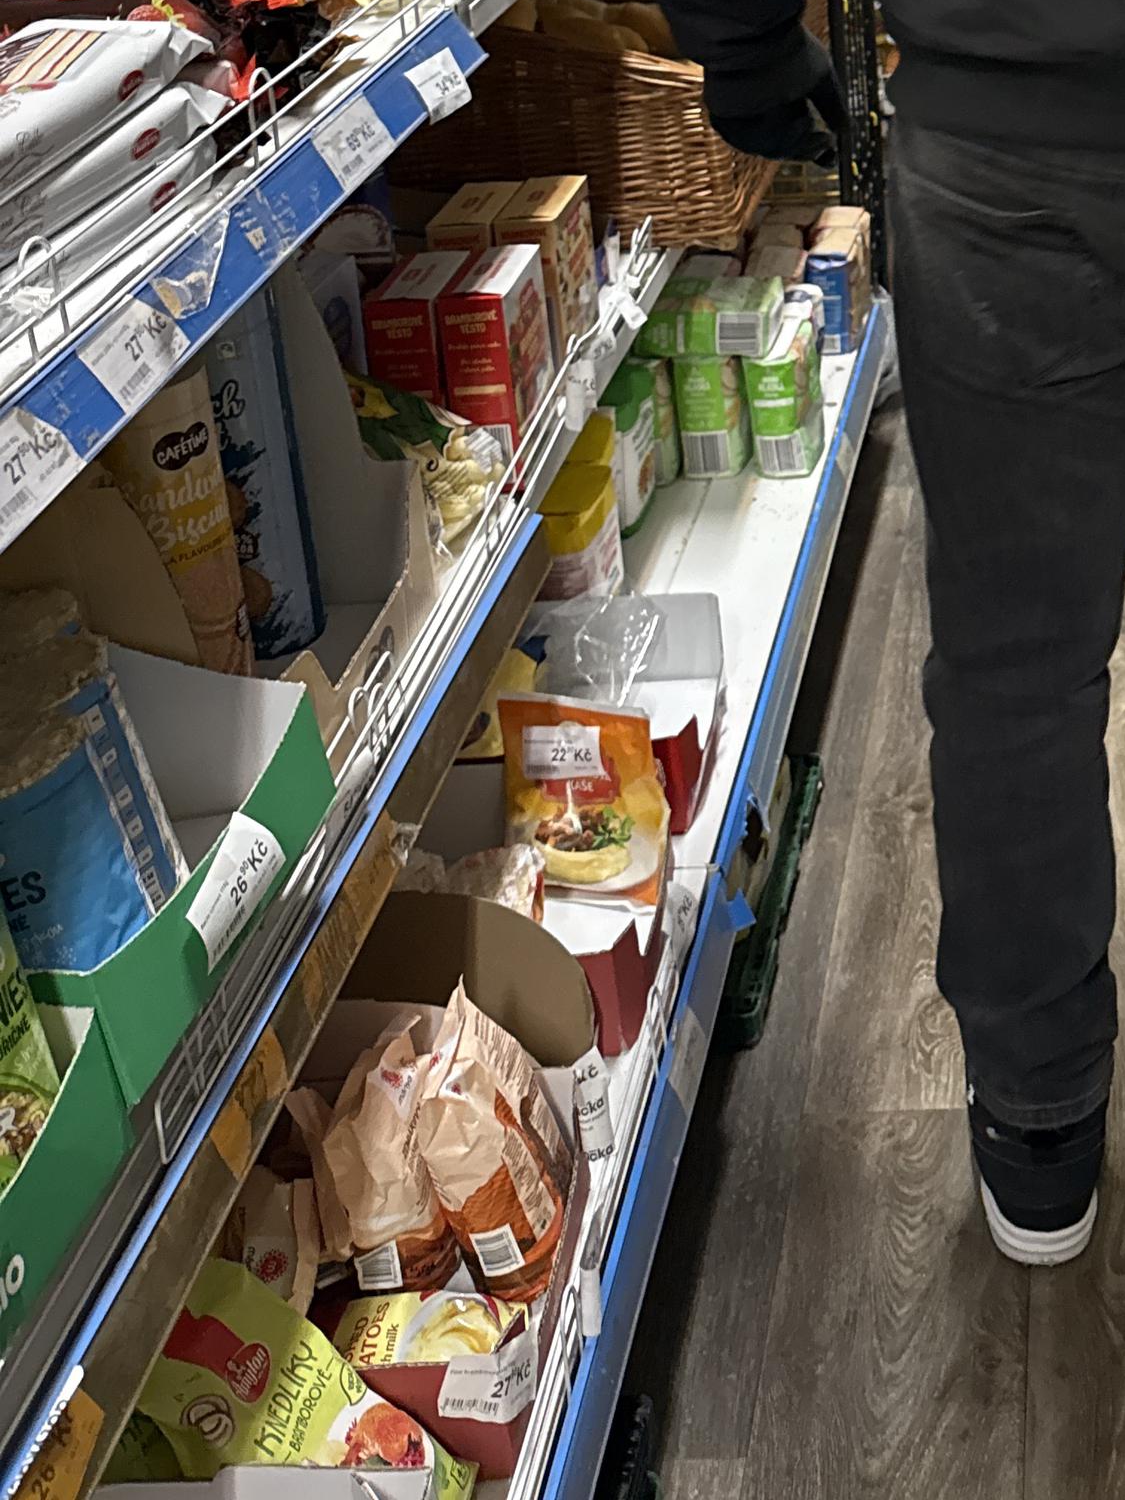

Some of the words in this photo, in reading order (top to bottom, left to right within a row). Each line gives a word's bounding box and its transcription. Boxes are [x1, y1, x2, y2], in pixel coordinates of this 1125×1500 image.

[573, 747, 593, 763] Kč
[246, 838, 269, 873] Kč
[253, 1339, 319, 1458] KNEDLÍKY
